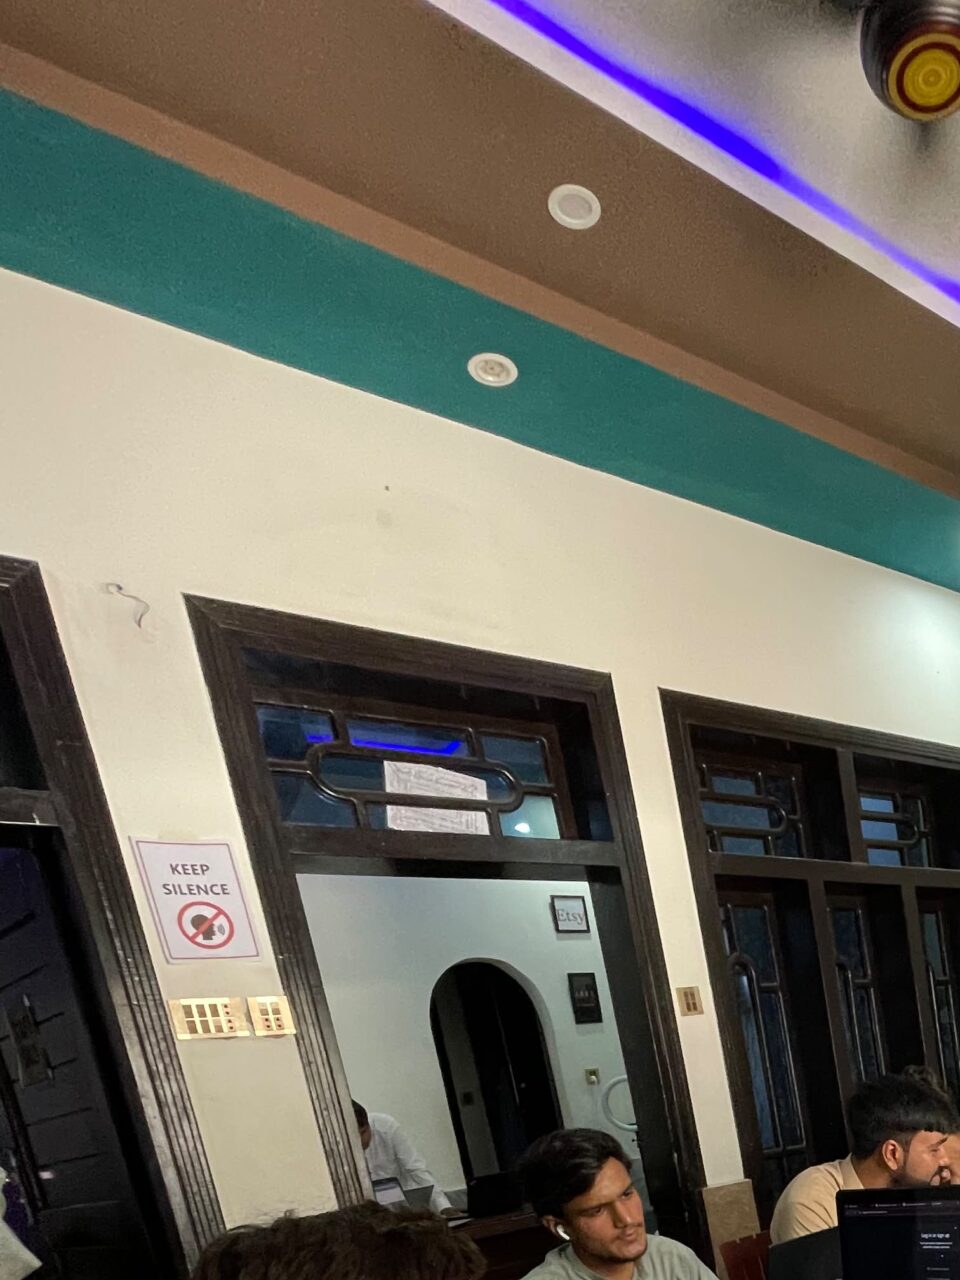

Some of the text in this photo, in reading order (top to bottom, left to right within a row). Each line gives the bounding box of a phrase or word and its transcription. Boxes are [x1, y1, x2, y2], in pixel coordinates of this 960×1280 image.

[169, 863, 210, 875] KEEP
[162, 883, 231, 896] SILENCE
[556, 908, 585, 925] Etsy
